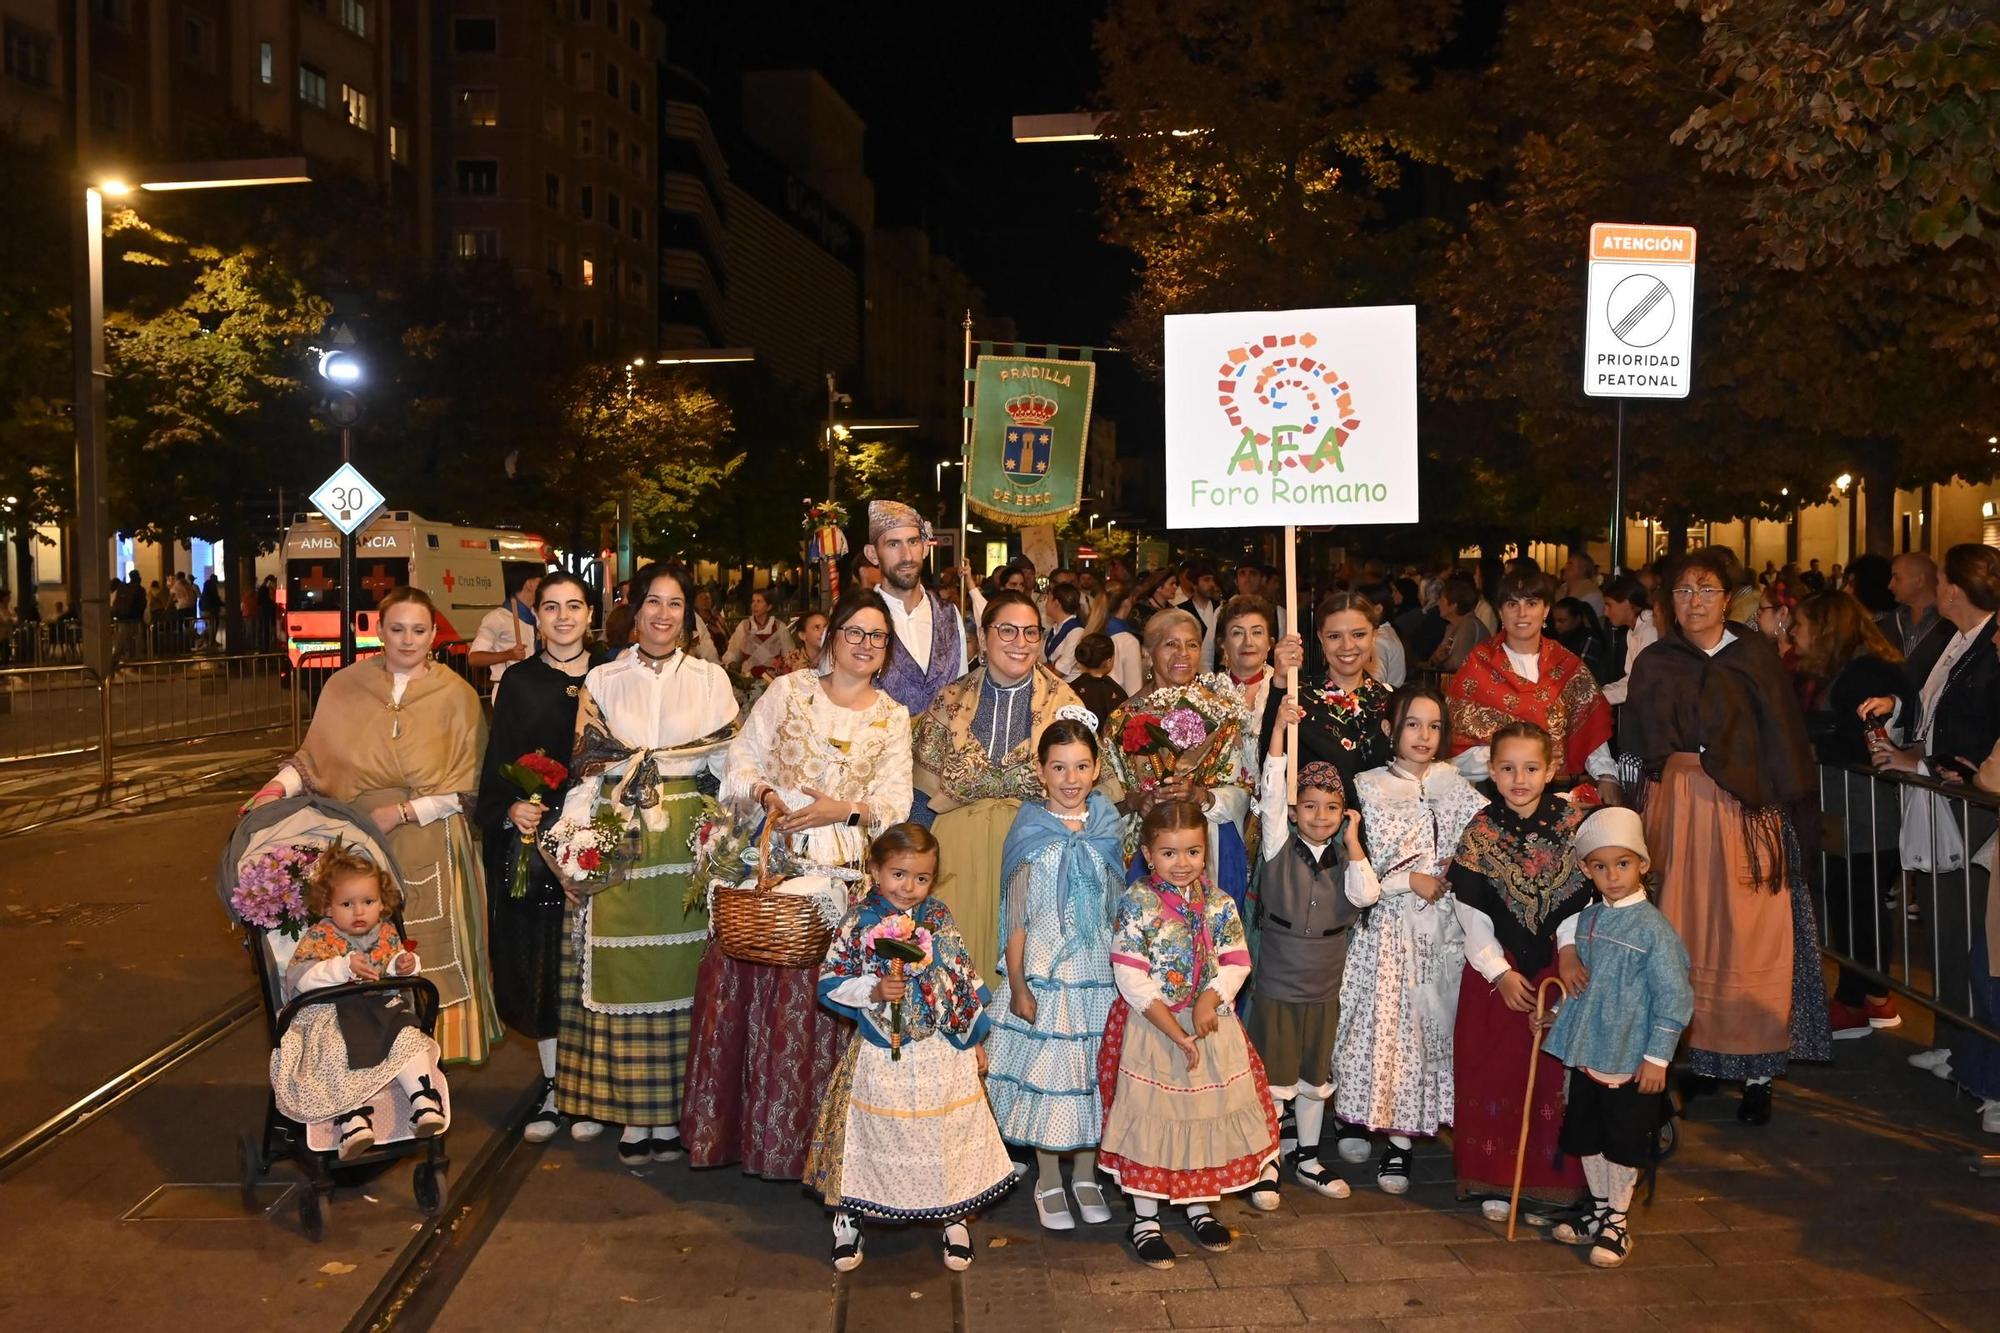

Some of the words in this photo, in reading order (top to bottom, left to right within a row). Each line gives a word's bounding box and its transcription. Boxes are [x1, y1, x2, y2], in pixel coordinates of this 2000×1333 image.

[1602, 235, 1684, 252] ATENCIÓN
[1597, 353, 1680, 367] PRIORIDAD
[1000, 366, 1071, 387] PRADILLA
[1598, 373, 1678, 387] PEATONAL
[1226, 425, 1345, 477] AFA
[331, 487, 364, 511] 30
[1191, 479, 1259, 507] Foro
[1271, 474, 1388, 505] Romano
[300, 536, 397, 549] AMBUANCIA
